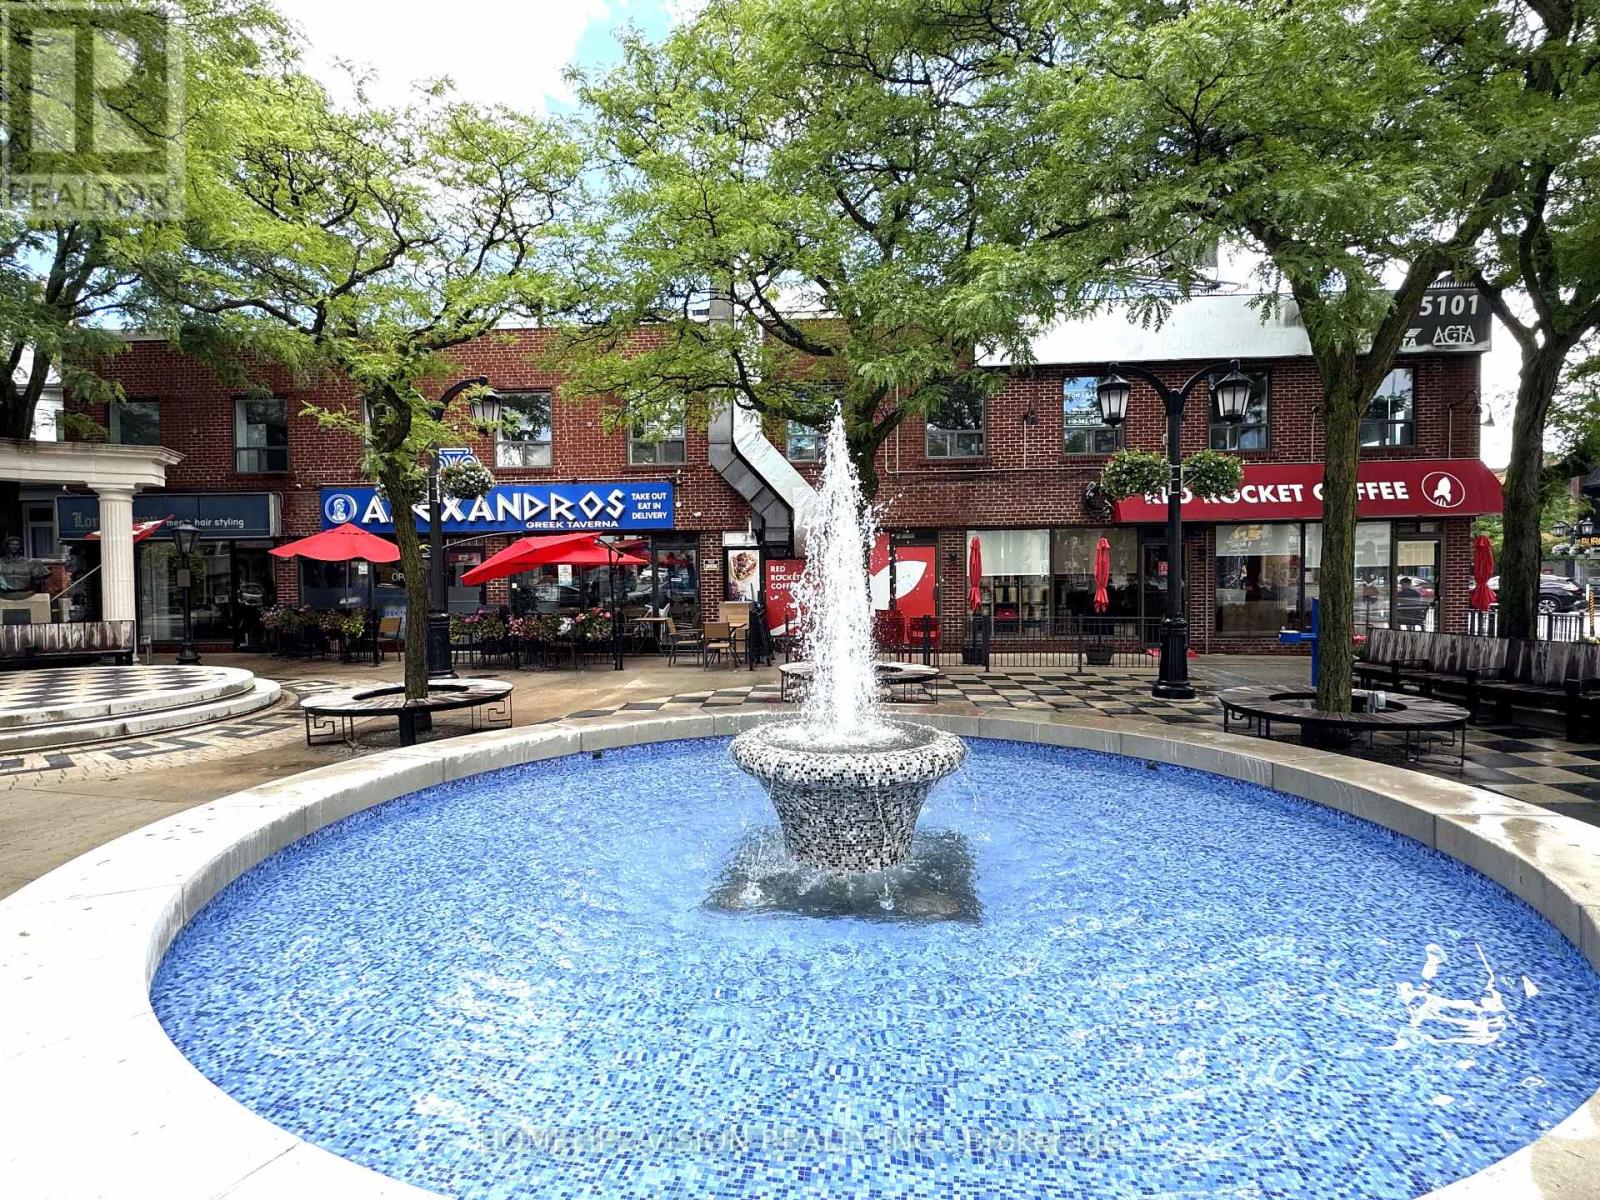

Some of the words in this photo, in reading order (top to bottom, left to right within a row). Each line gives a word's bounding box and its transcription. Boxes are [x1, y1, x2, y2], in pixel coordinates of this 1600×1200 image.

[1418, 294, 1480, 316] 5101
[631, 492, 650, 501] TAKE
[651, 491, 668, 500] OUT
[1312, 481, 1410, 501] CFFEE
[362, 488, 626, 523] AXANDROS
[637, 501, 651, 510] EAT
[652, 501, 662, 510] IN
[631, 511, 668, 520] DELIVERY
[194, 518, 211, 527] hair
[214, 518, 244, 529] styling
[525, 520, 564, 529] GREEK
[566, 520, 619, 528] TAVERNA
[770, 565, 786, 573] RED
